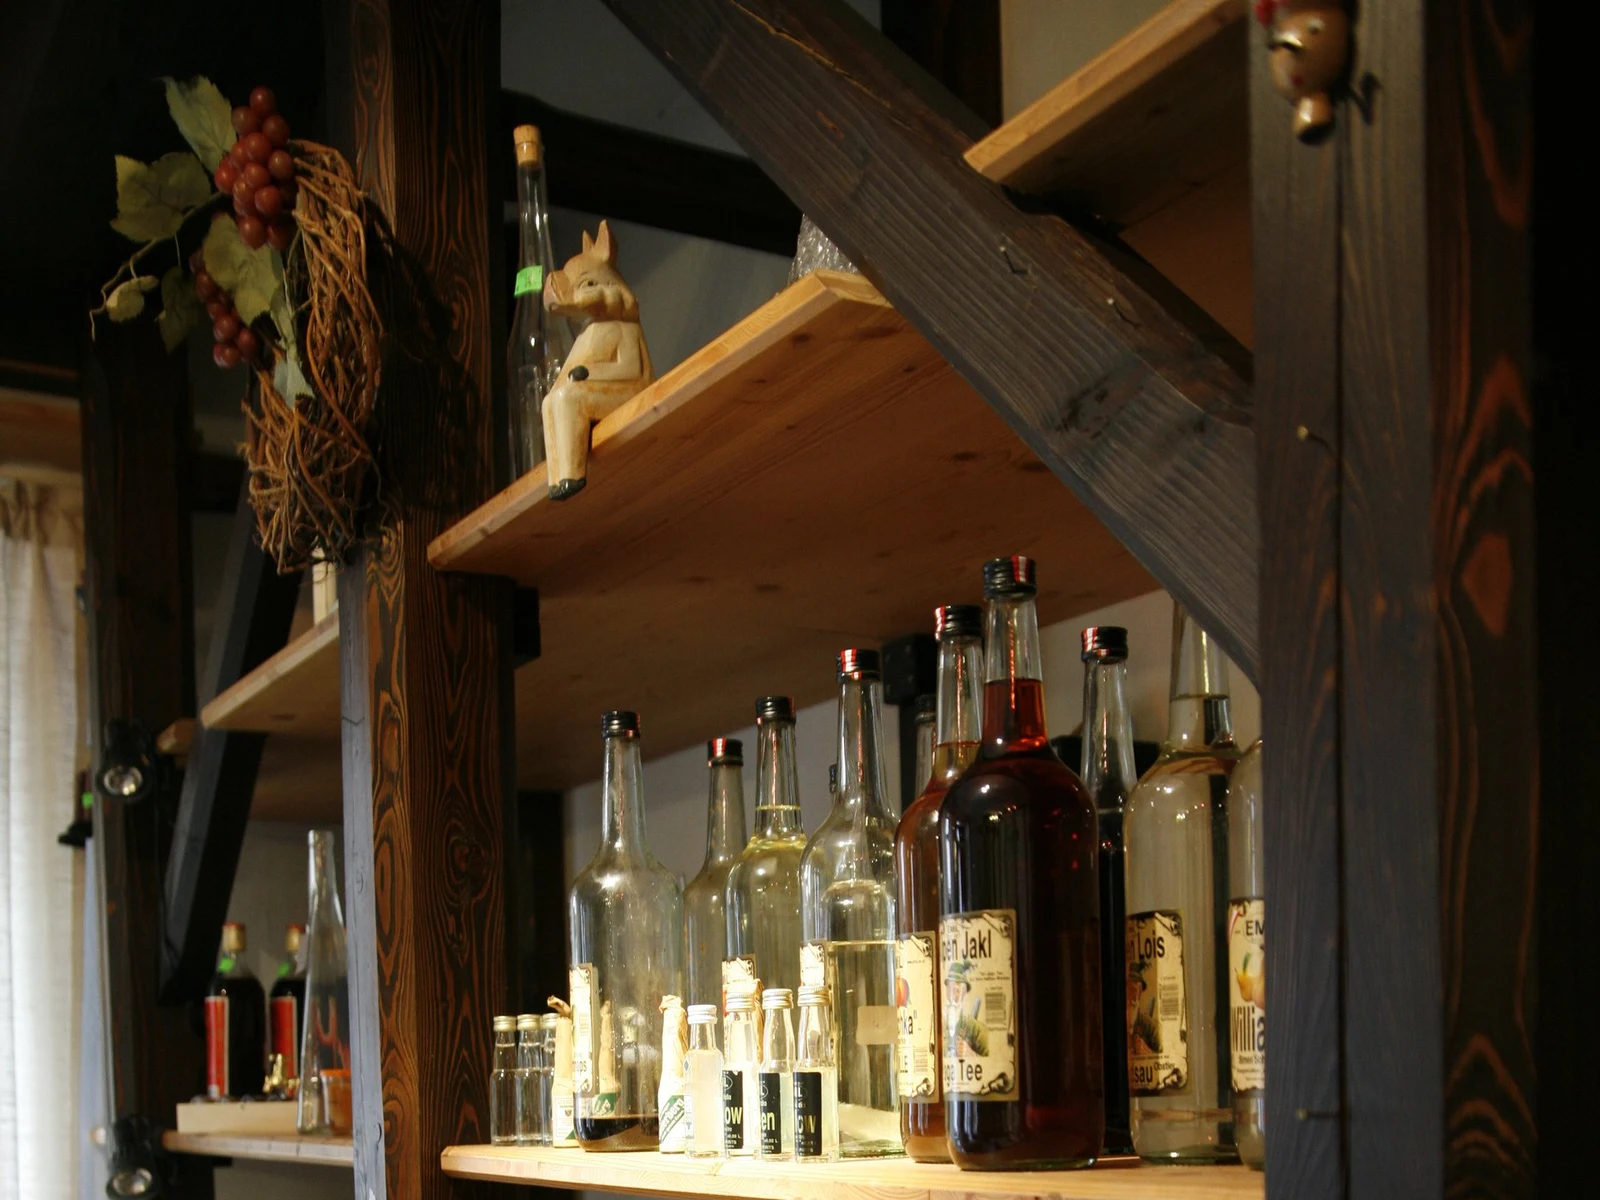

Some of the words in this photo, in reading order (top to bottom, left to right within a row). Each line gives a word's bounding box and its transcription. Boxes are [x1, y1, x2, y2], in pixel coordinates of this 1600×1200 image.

[962, 928, 991, 960] Jakl
[1138, 929, 1166, 960] Lois
[958, 1058, 983, 1081] Tee
